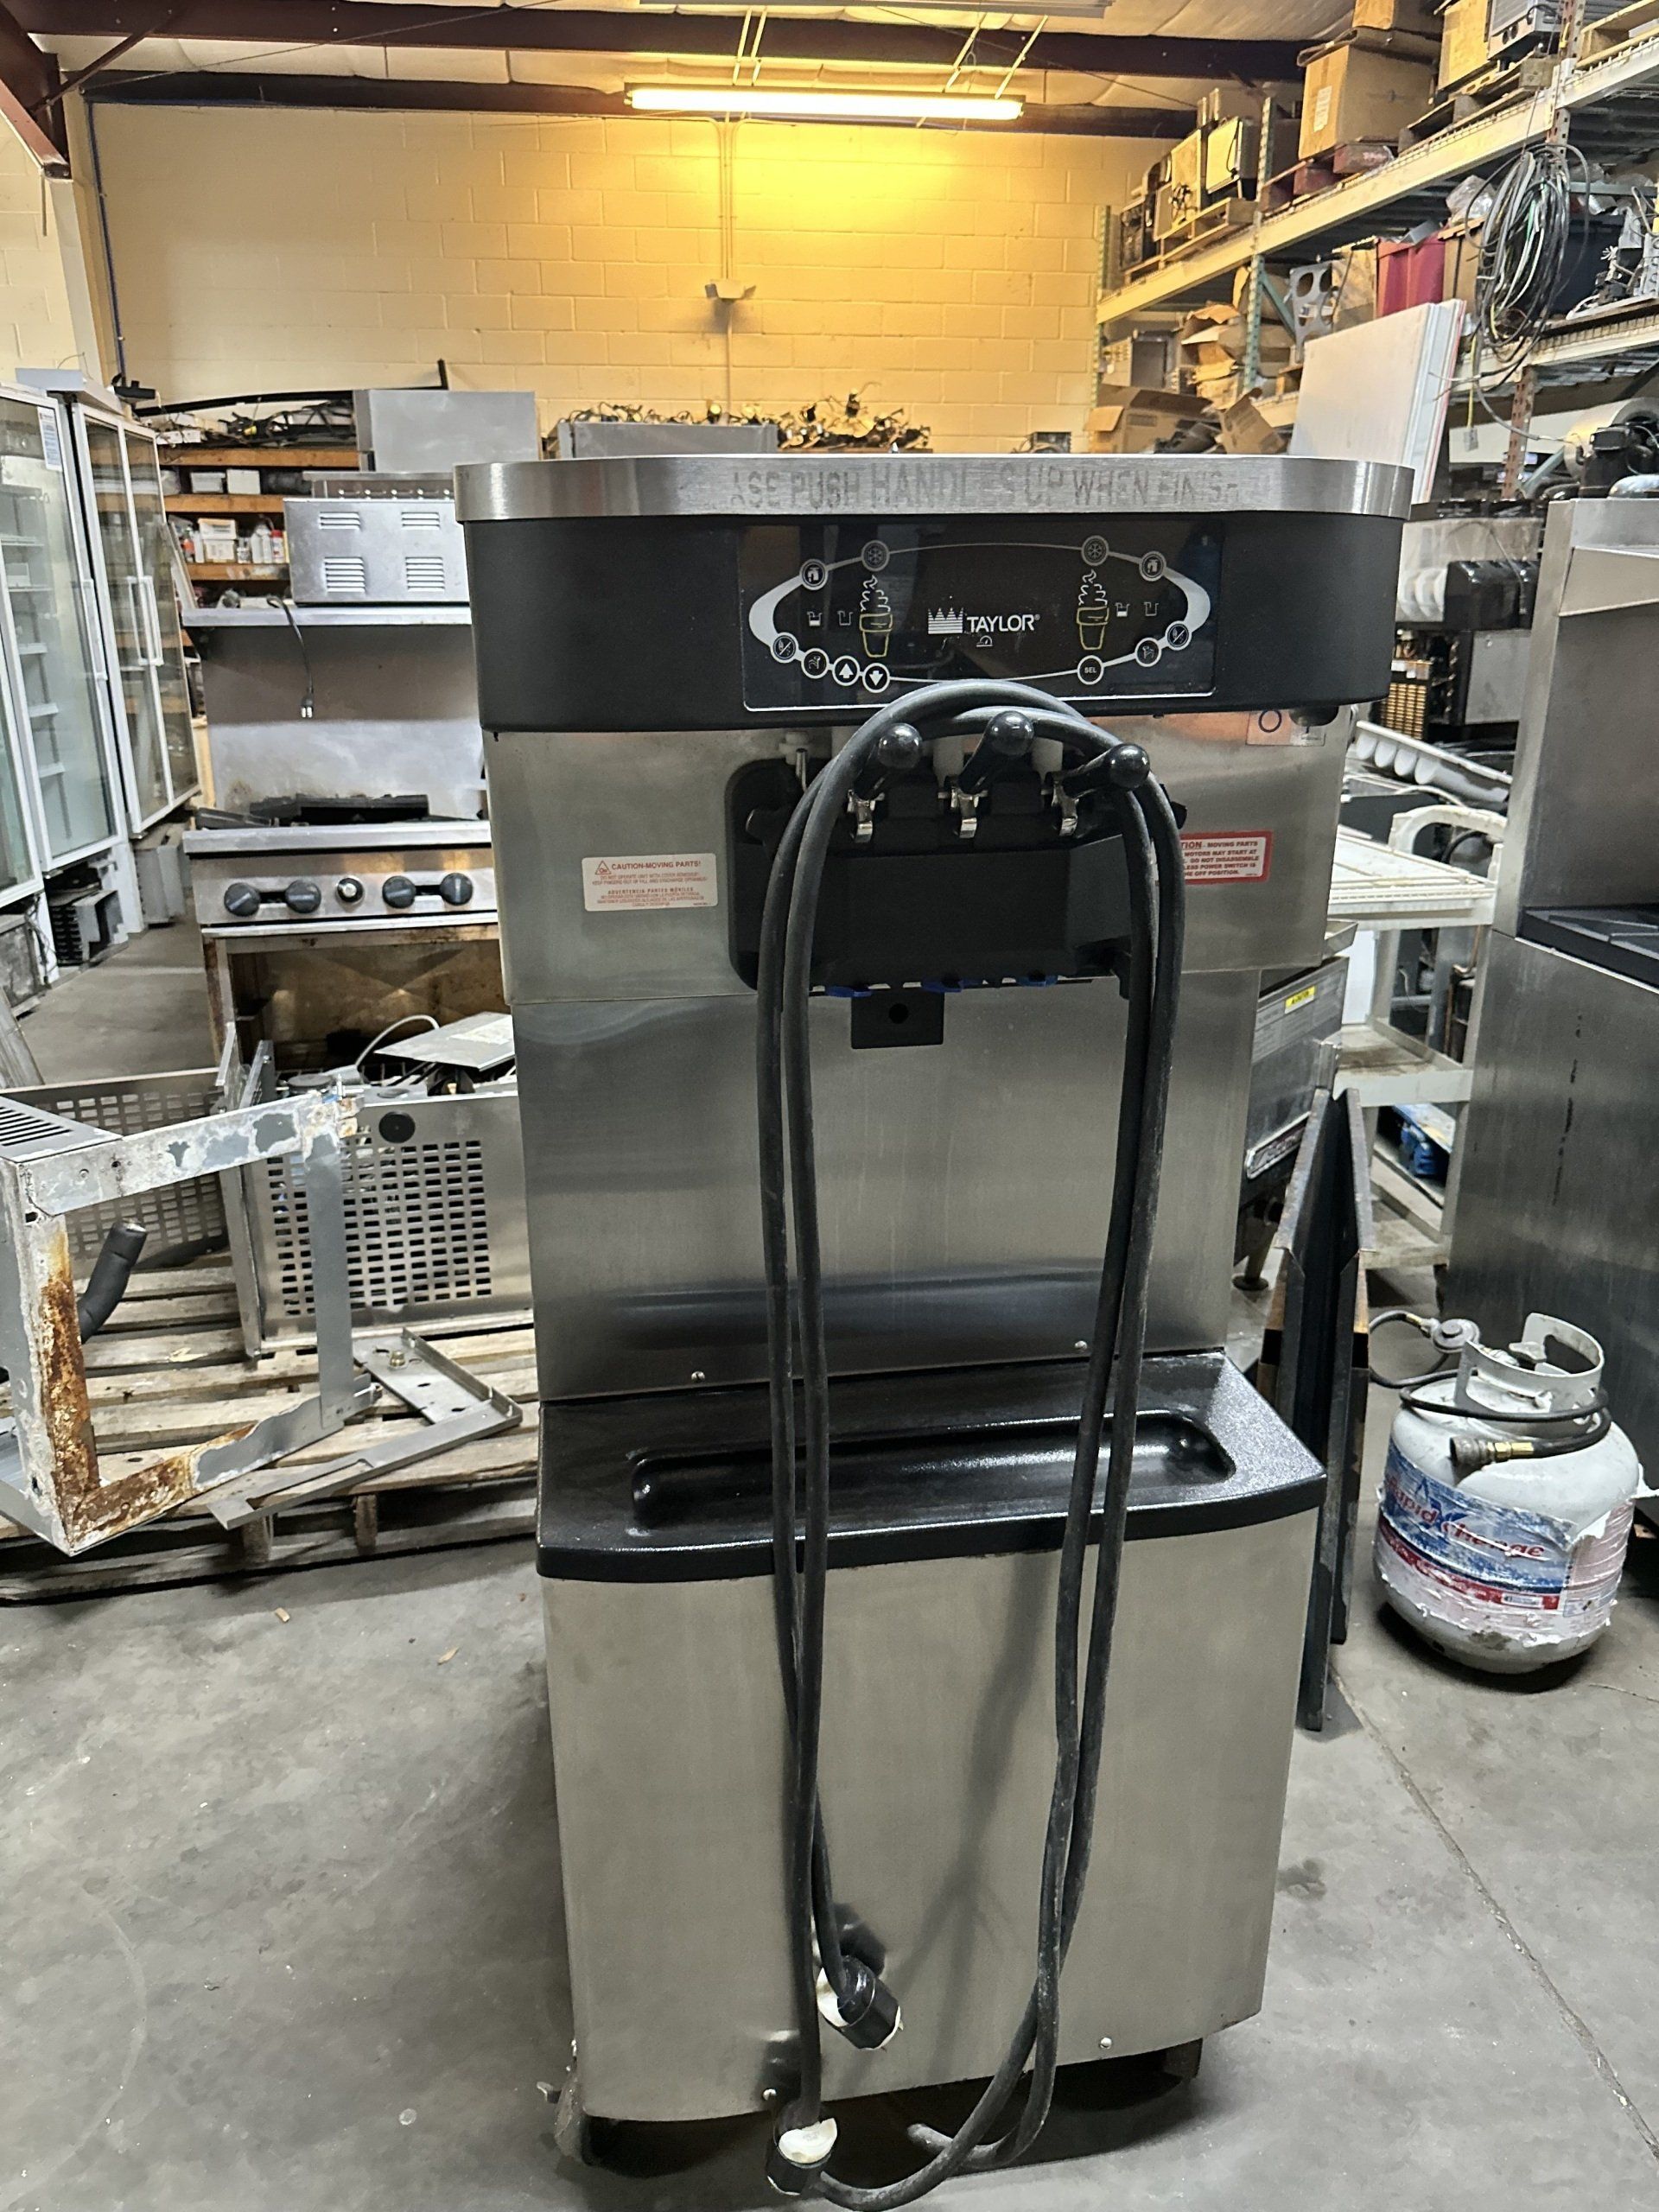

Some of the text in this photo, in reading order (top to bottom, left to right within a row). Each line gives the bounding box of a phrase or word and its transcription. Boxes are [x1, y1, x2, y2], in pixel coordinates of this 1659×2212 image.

[790, 469, 861, 511] PUSH
[1025, 460, 1064, 508] UP
[966, 614, 1035, 633] TAYLOR
